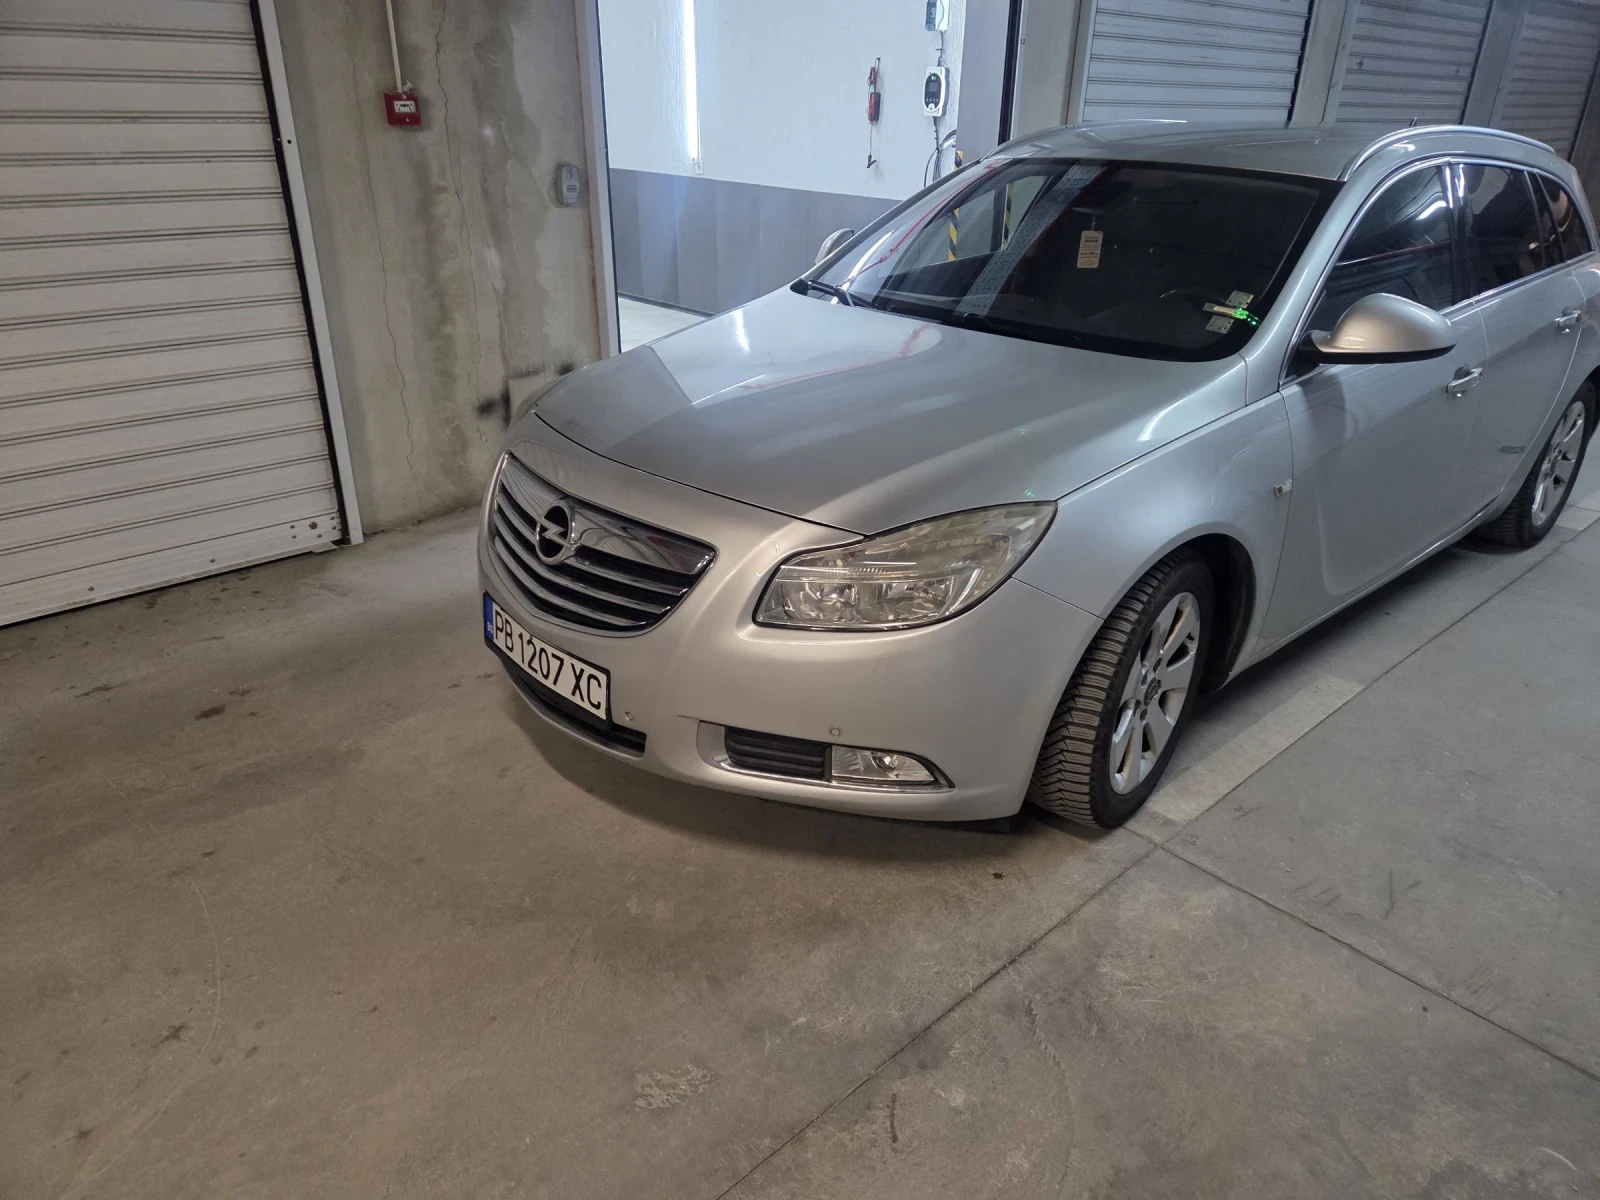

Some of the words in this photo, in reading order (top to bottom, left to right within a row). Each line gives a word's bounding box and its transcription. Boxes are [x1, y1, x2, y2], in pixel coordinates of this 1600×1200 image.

[495, 610, 514, 653] PB
[518, 632, 565, 686] 1207
[570, 662, 602, 710] XC
